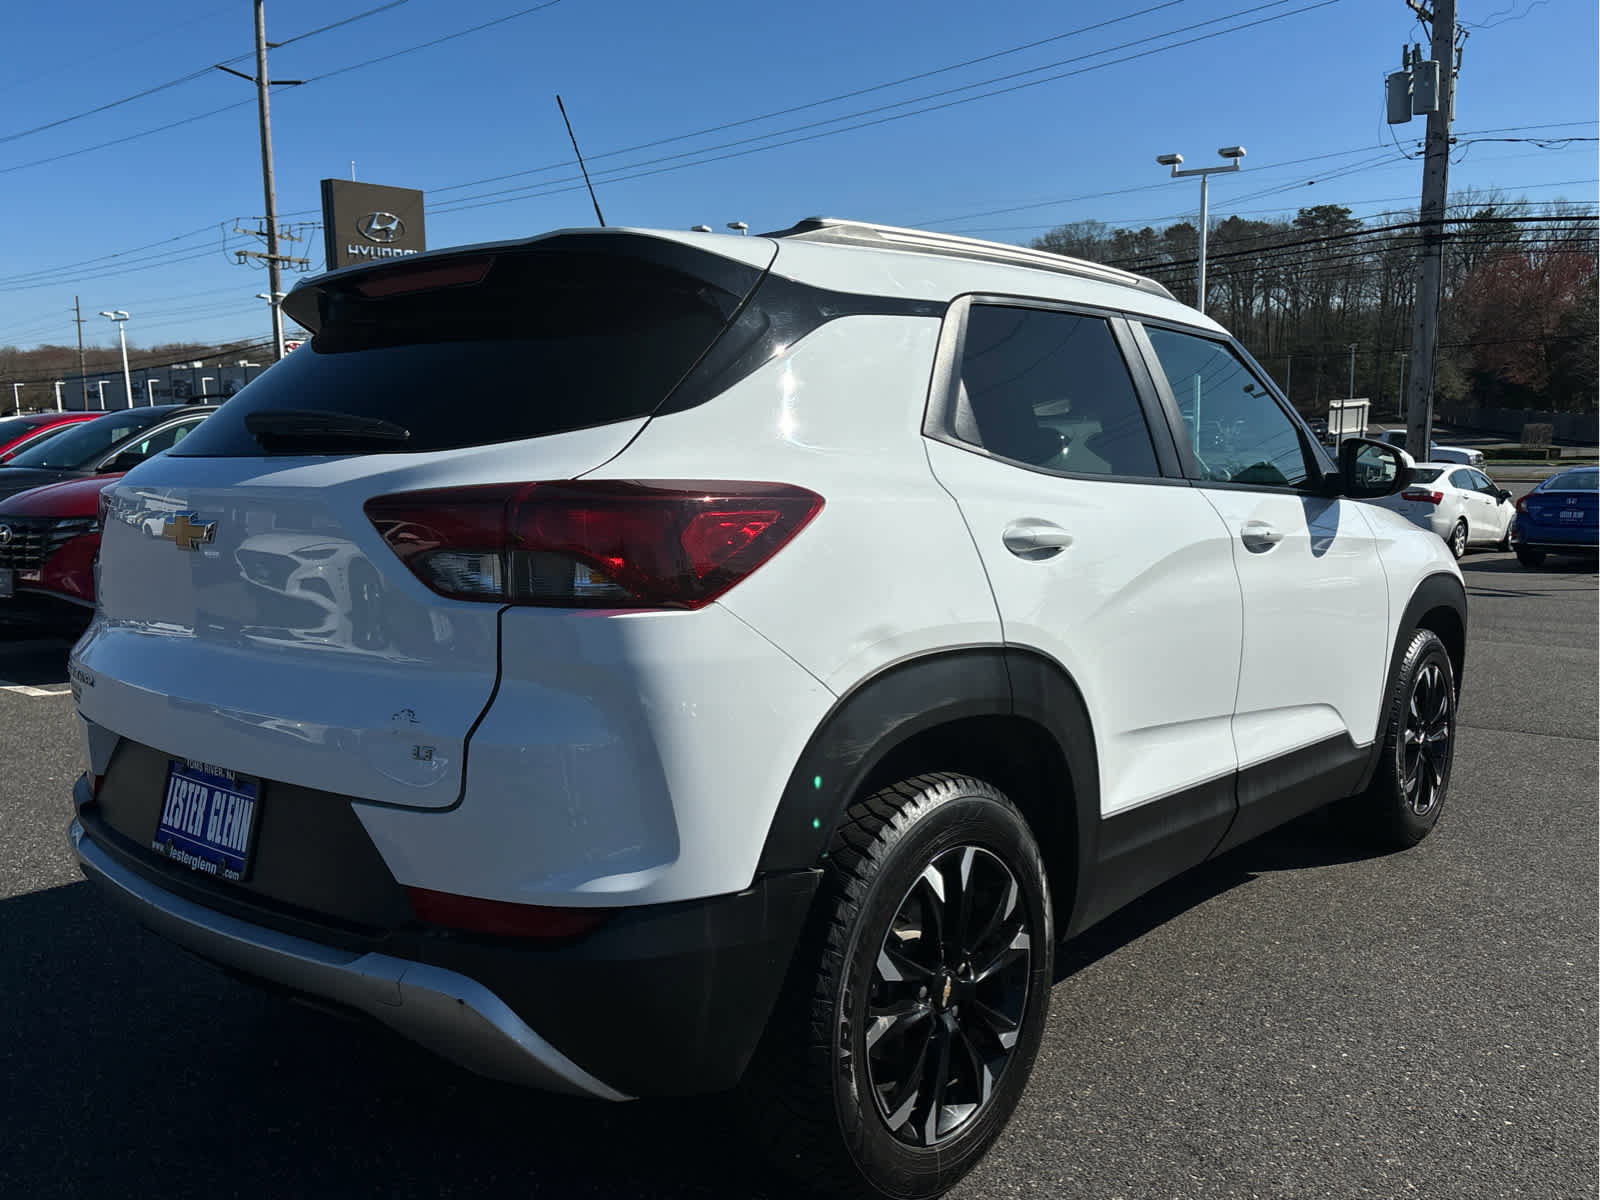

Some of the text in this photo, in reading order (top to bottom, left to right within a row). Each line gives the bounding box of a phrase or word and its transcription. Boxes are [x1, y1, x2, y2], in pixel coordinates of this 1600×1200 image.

[347, 244, 418, 260] HYUND
[162, 776, 254, 852] LESTER GLENN
